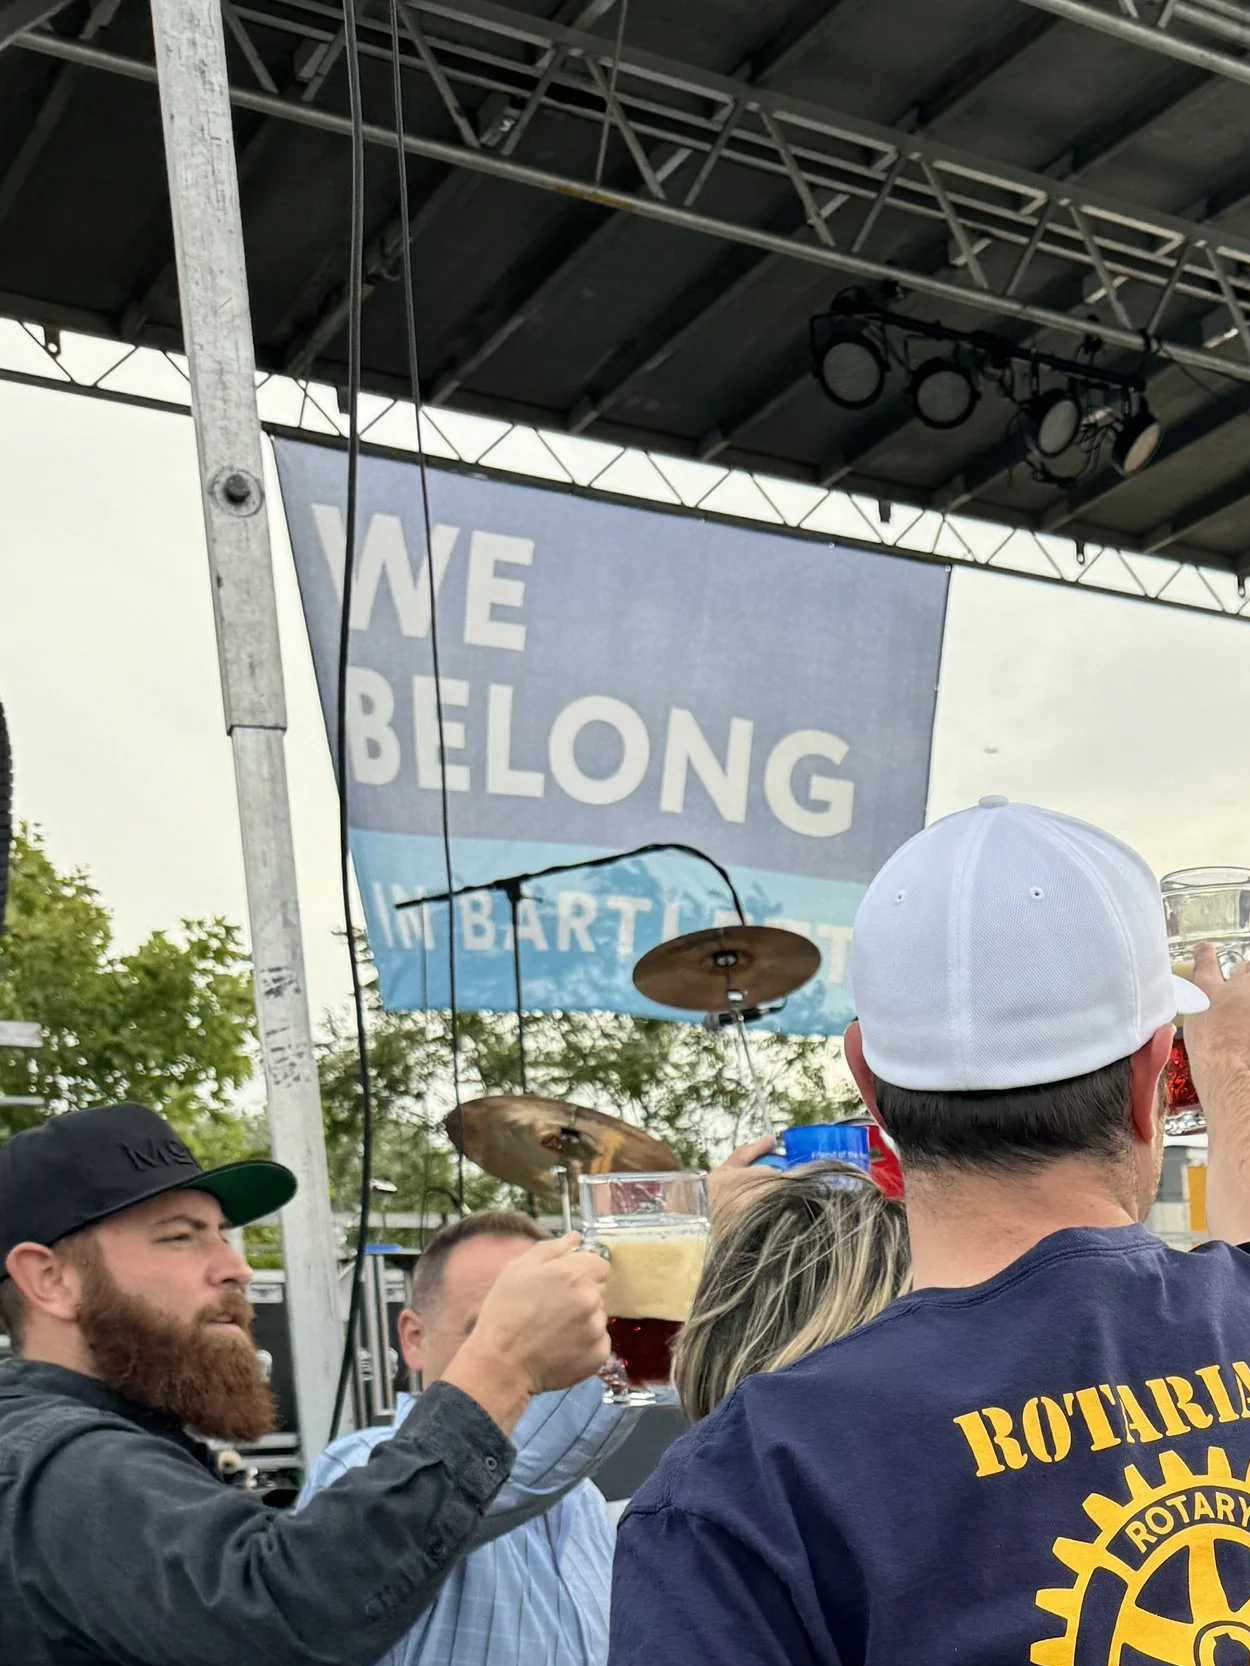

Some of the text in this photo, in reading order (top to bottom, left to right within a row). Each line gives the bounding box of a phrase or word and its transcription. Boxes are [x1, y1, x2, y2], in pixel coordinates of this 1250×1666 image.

[310, 502, 535, 652] WE
[345, 665, 854, 837] BELONG
[372, 881, 853, 985] IN BARTT
